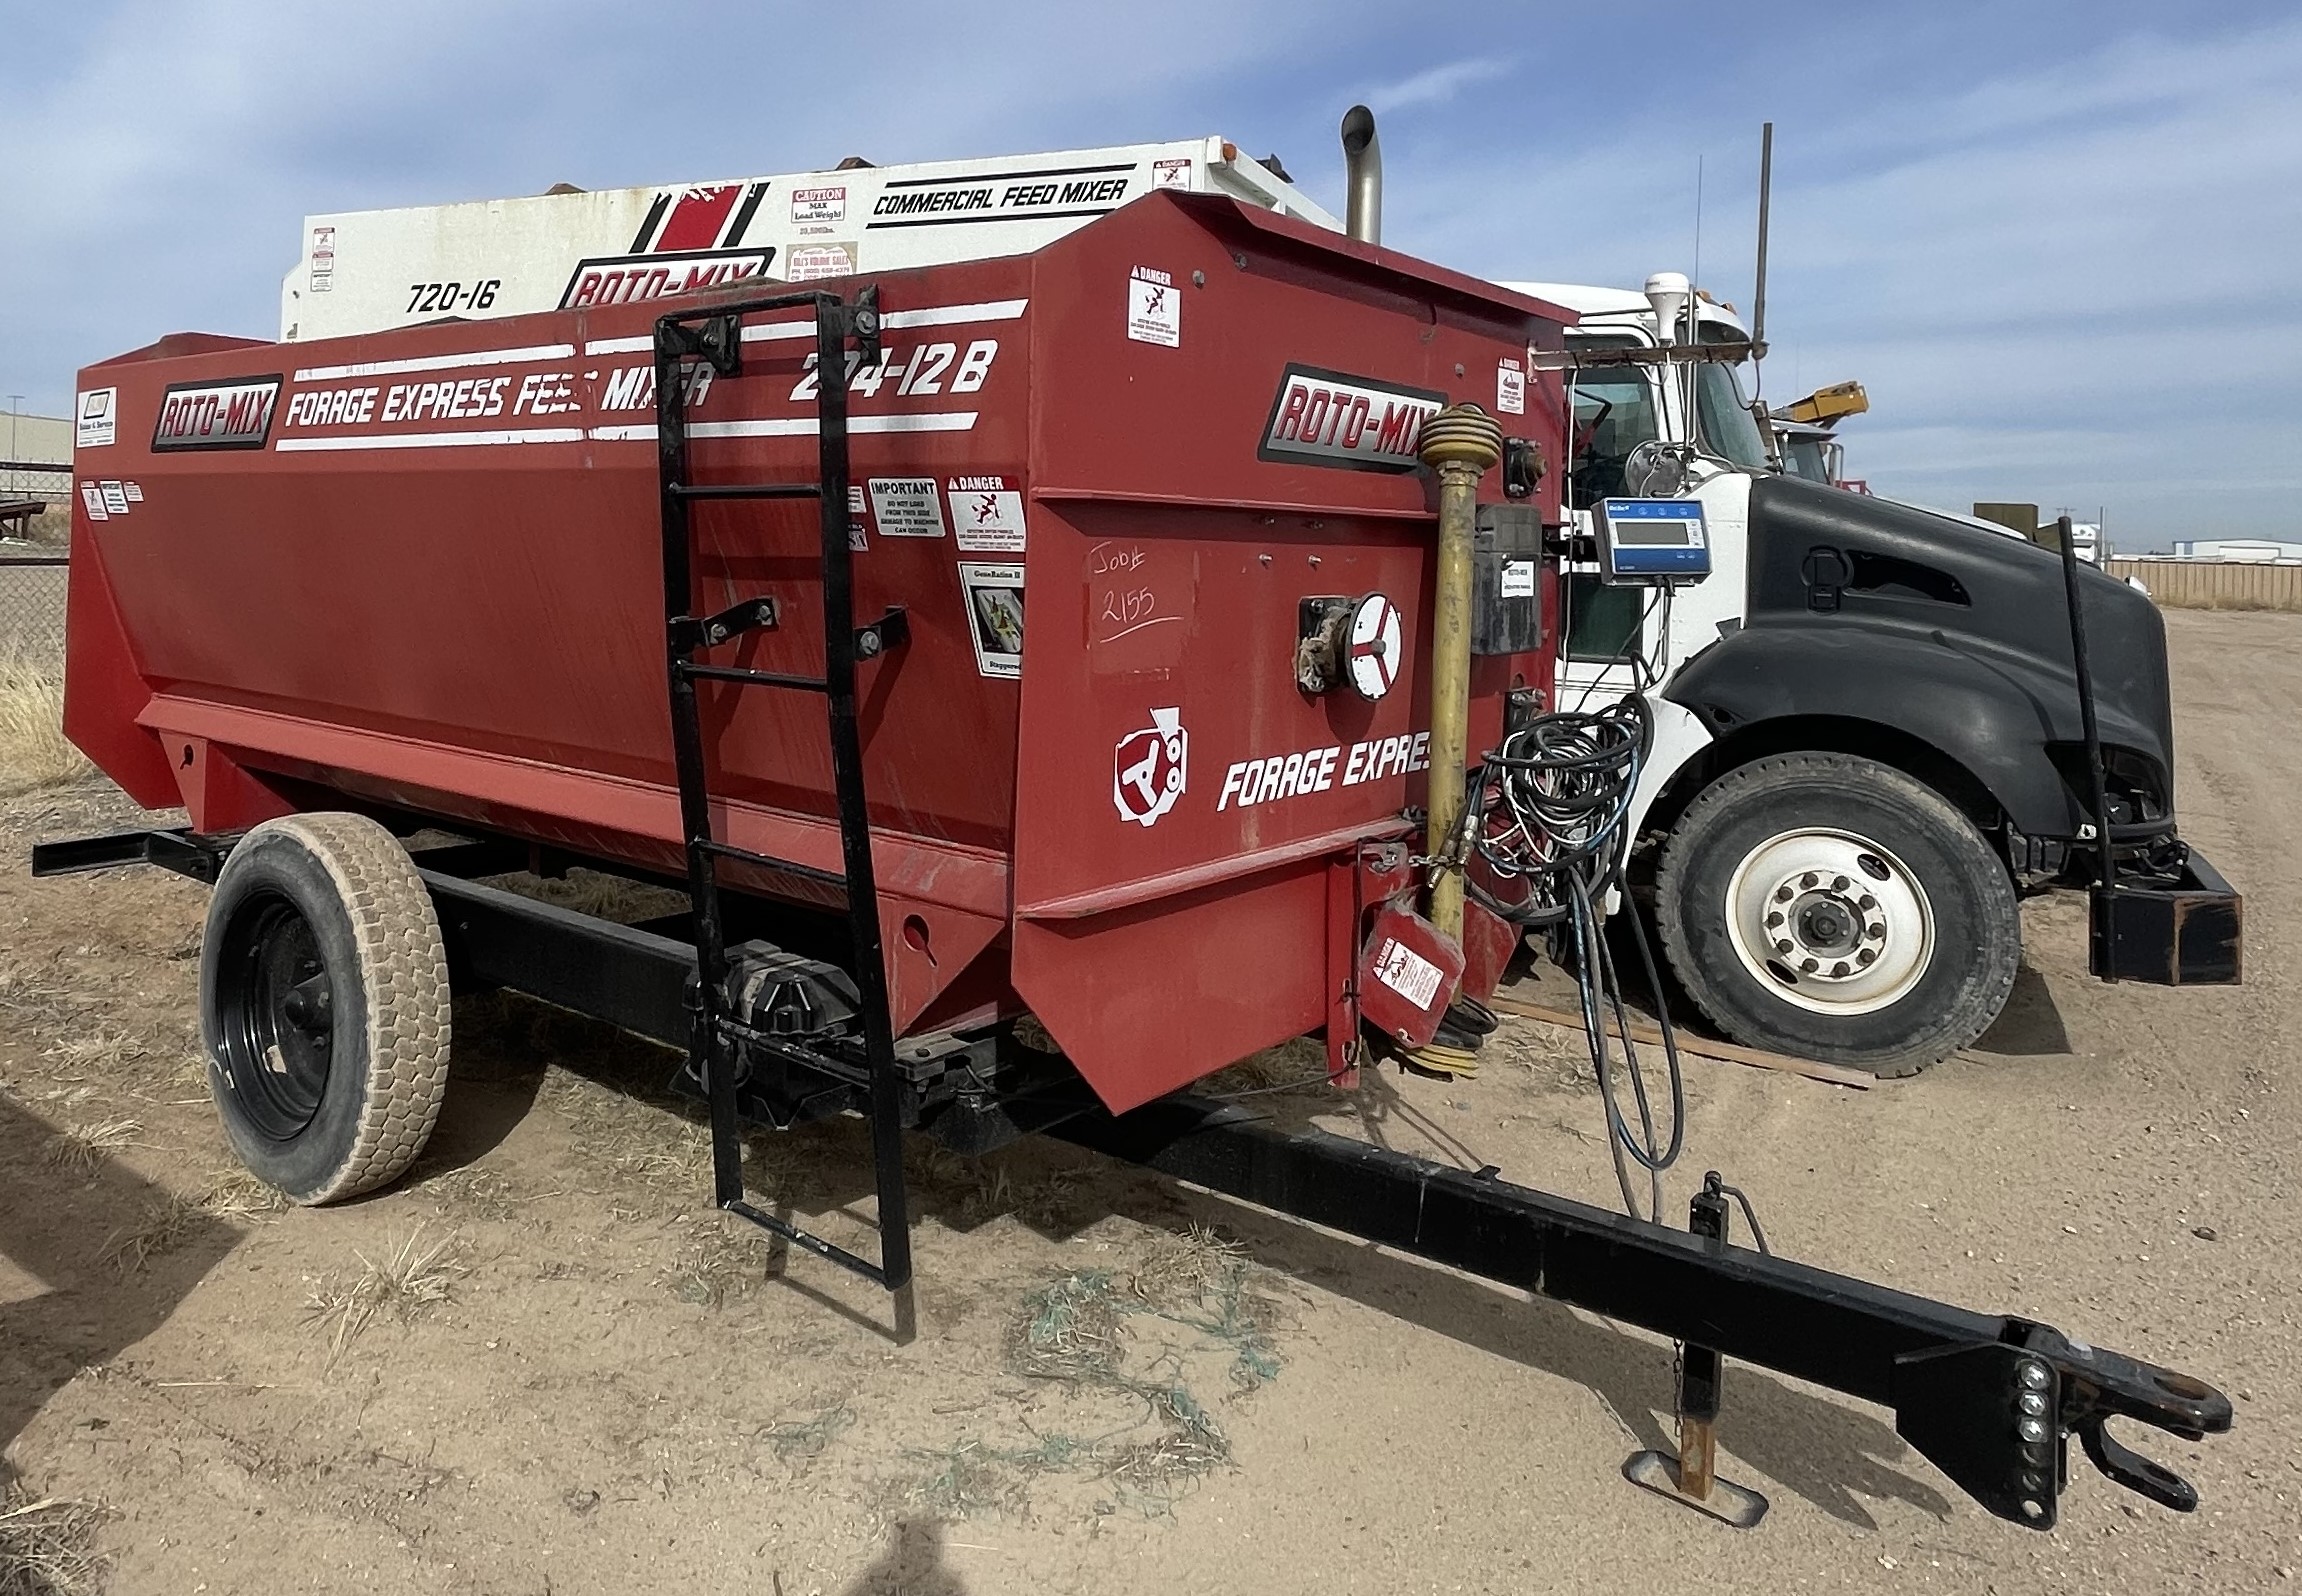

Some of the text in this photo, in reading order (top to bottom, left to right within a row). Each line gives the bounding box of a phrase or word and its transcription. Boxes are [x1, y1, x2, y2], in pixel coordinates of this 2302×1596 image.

[795, 188, 842, 201] CAUTION
[873, 178, 1128, 215] COMMERCIAL FEED MIXER
[795, 210, 842, 220] Load Weight
[1140, 266, 1171, 286] DANGER
[406, 280, 501, 313] 720-16
[160, 390, 273, 438] ROTO-MIX
[285, 387, 380, 427] FORAGE
[381, 376, 512, 422] EXPRESS
[512, 370, 598, 416] FEE
[1274, 383, 1437, 456] ROTO-MIX
[871, 482, 935, 495] IMPORTANT
[959, 476, 1004, 490] DANGER
[1101, 586, 1155, 623] 2155
[1216, 731, 1431, 812] FORAGE EXPRE
